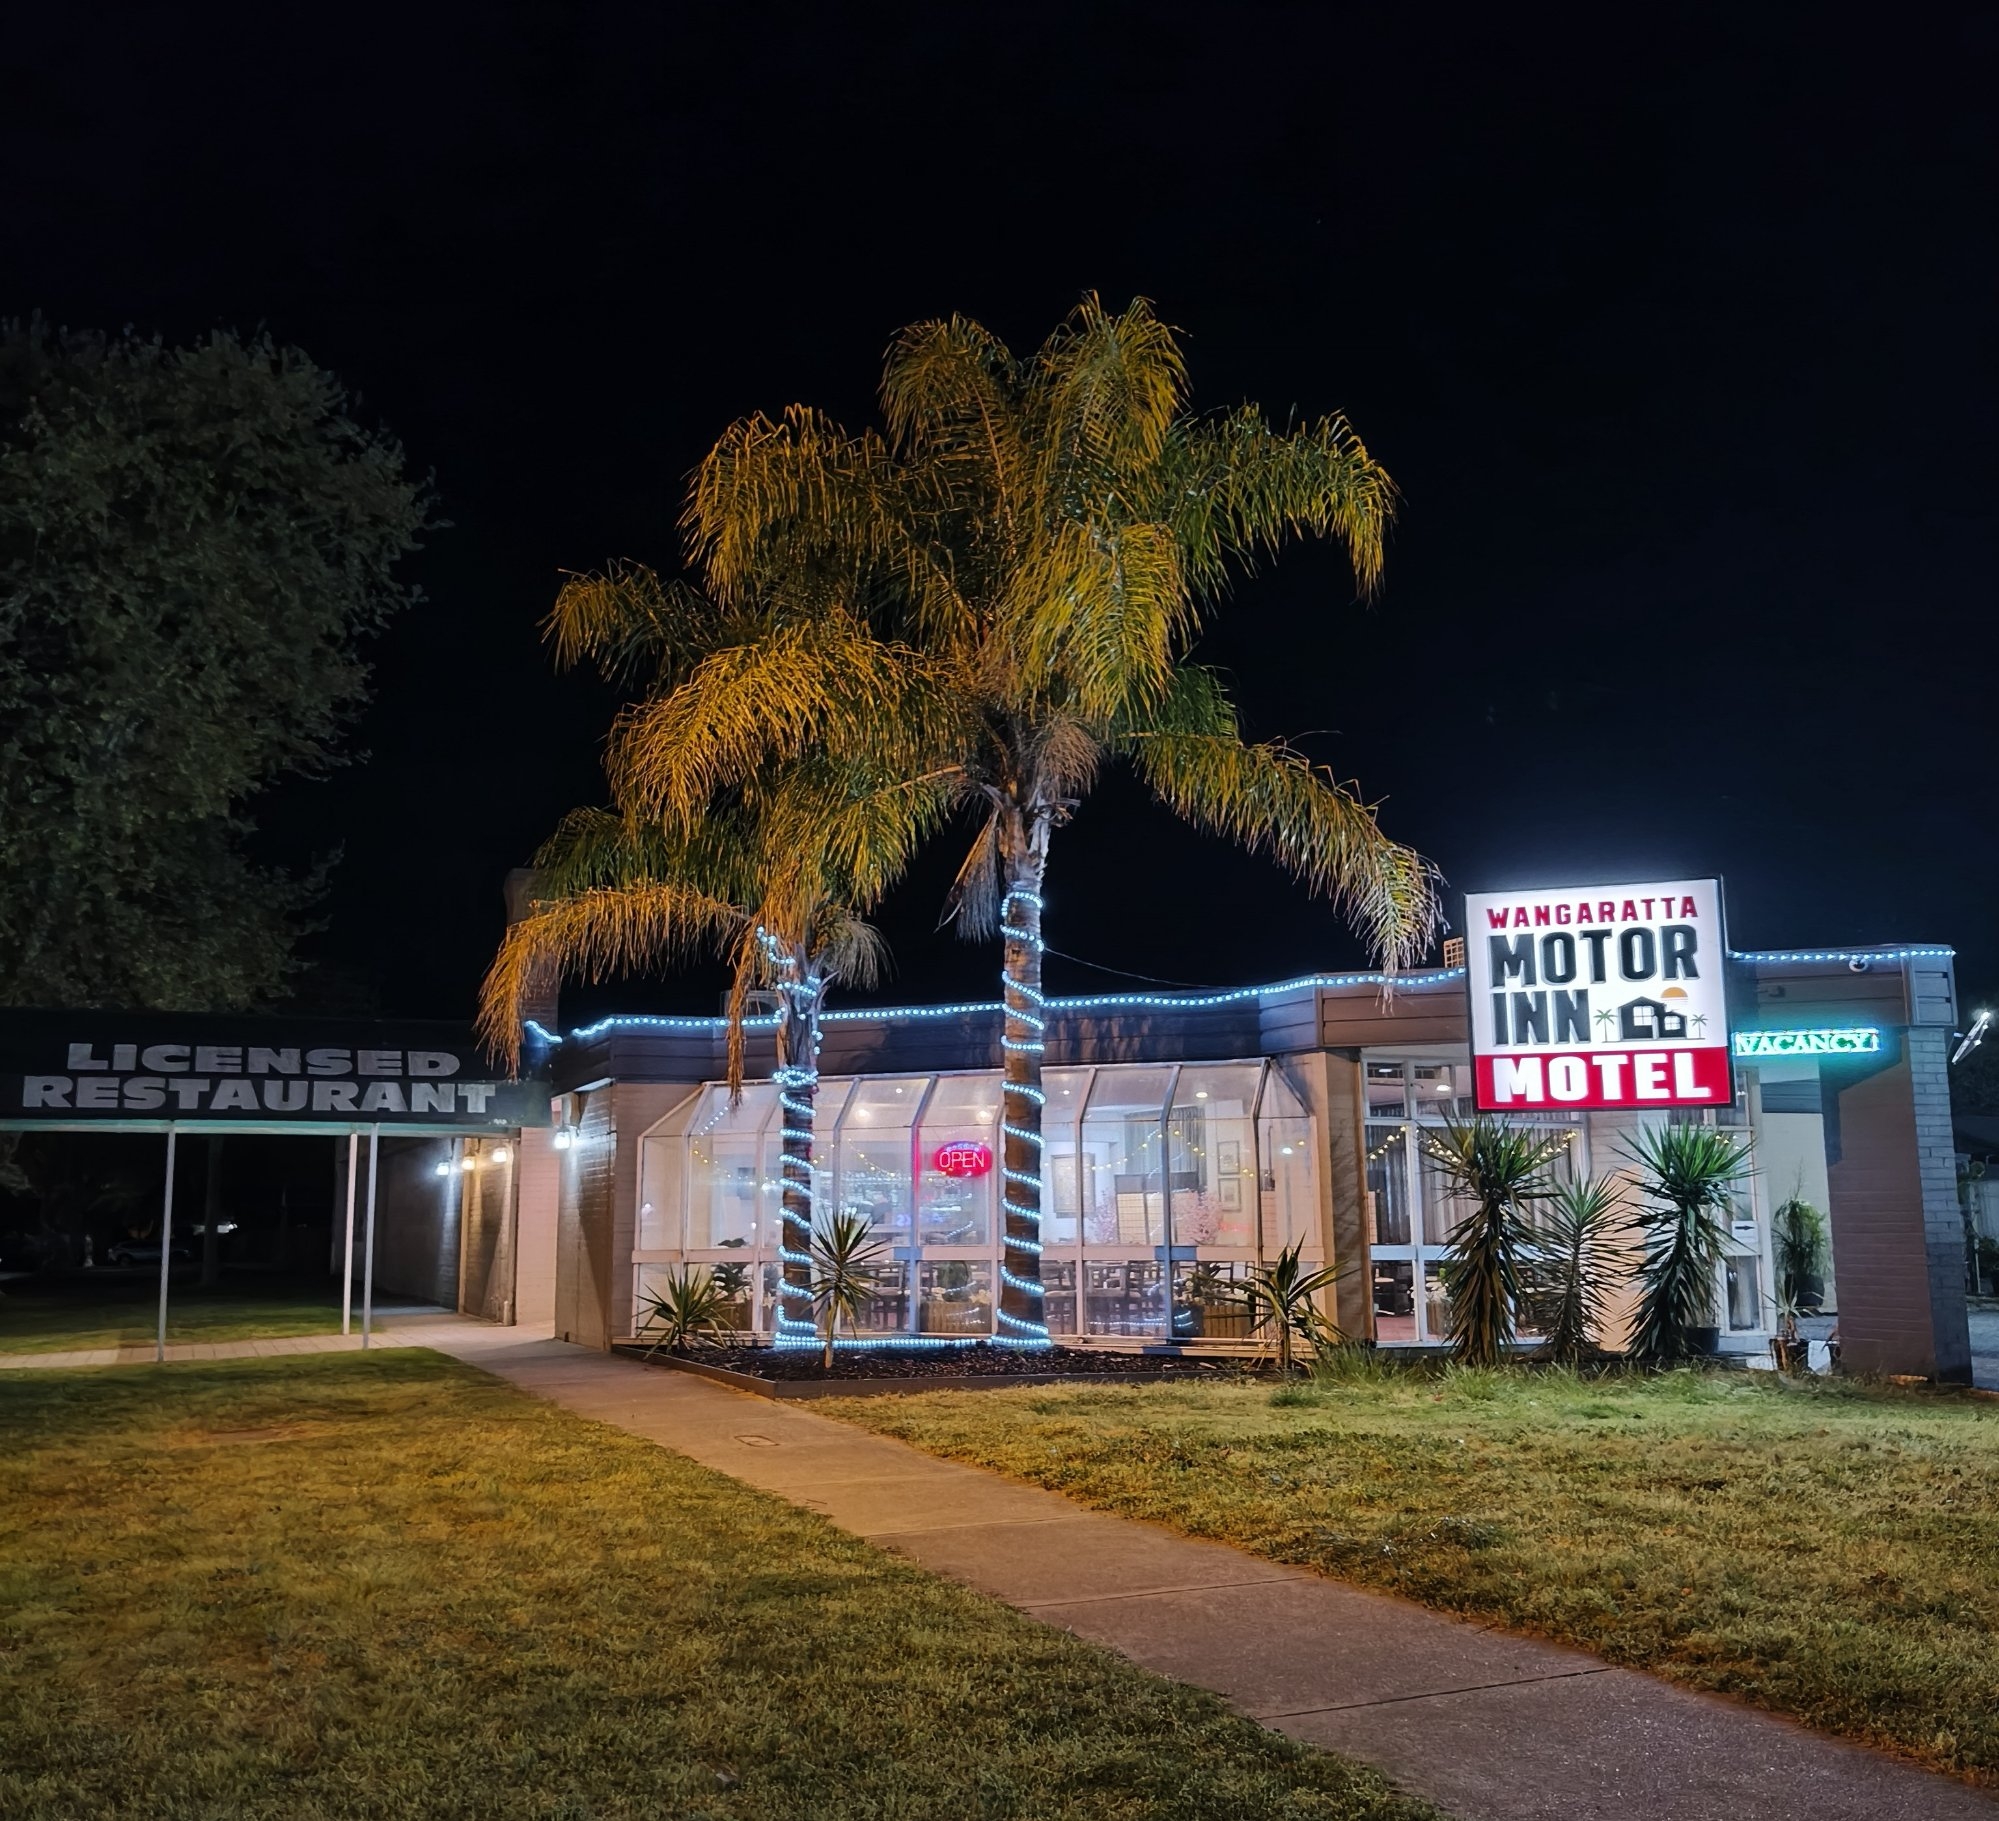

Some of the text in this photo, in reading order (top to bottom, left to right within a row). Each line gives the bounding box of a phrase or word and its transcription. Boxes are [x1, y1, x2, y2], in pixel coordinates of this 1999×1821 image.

[1486, 896, 1698, 929] WANGARATTA
[1487, 925, 1701, 989] MOTOR
[1490, 988, 1592, 1047] INN
[67, 1043, 460, 1077] LICENSED
[1737, 1032, 1868, 1054] VACANCY
[22, 1076, 496, 1113] RESTAURANT
[1493, 1052, 1712, 1103] MOTEL
[940, 1151, 985, 1168] OPEN
